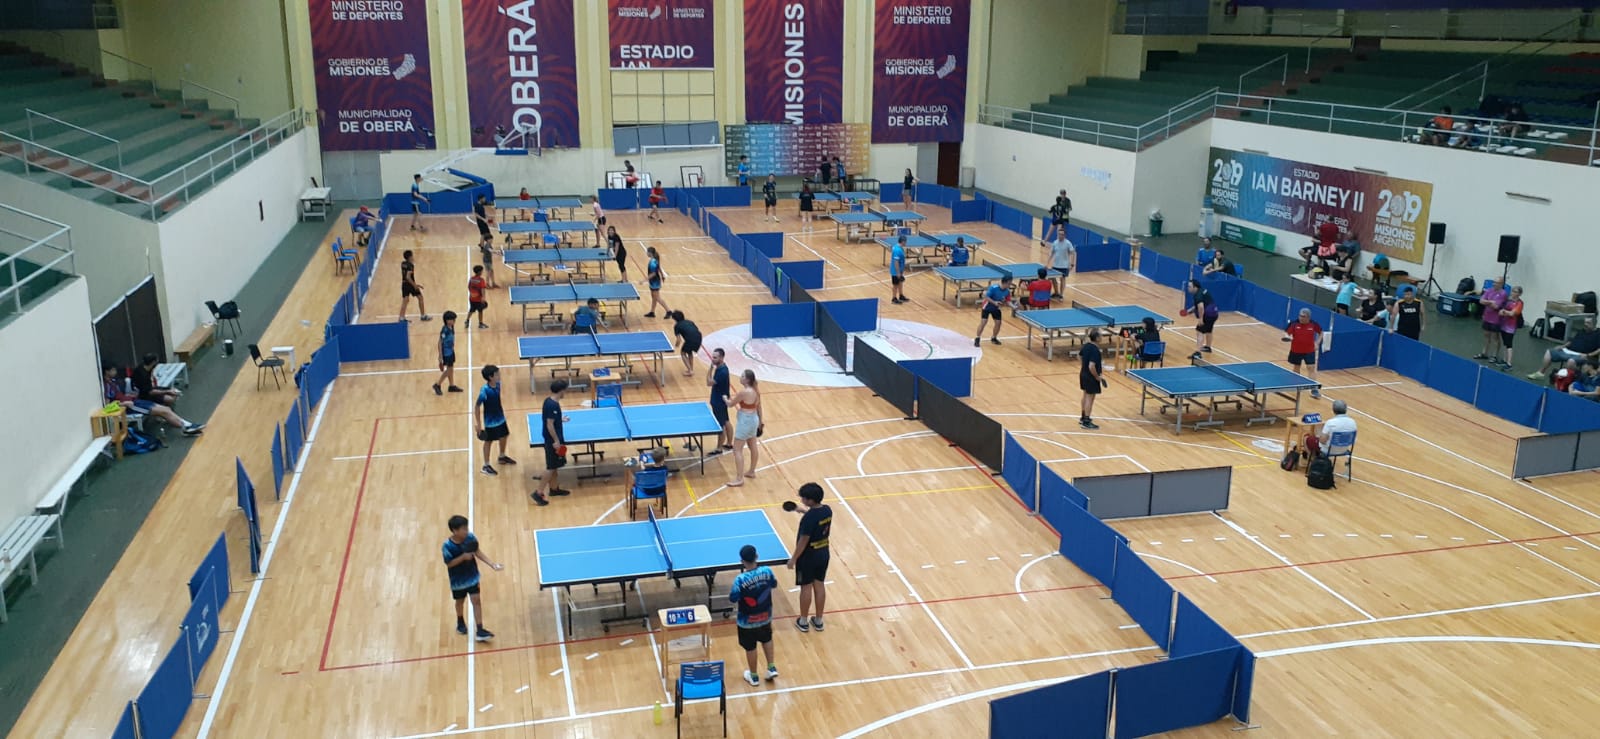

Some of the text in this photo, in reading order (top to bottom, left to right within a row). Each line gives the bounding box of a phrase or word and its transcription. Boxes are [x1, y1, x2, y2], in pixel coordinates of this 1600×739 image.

[332, 1, 404, 11] MINISTERIO
[893, 6, 952, 16] MINISTERIO
[333, 12, 404, 20] DE DEPORTES
[893, 16, 951, 24] DE DEPORTES
[620, 45, 694, 59] ESTADIO
[328, 58, 389, 66] GOBIERNO DE
[329, 66, 391, 76] MISIONES
[885, 66, 935, 75] MISIONES
[888, 104, 949, 113] MUNICIPALIDAD
[338, 109, 412, 119] MUNICIPALIDAD
[888, 113, 949, 126] DE OBERÁ
[340, 118, 415, 133] DE OBERÁ
[1293, 168, 1320, 180] ESTADIO
[1252, 170, 1365, 213] IAN BARNEY II
[1375, 223, 1415, 241] MISIONES
[1373, 233, 1414, 250] ARGENTINA
[687, 611, 694, 621] 6
